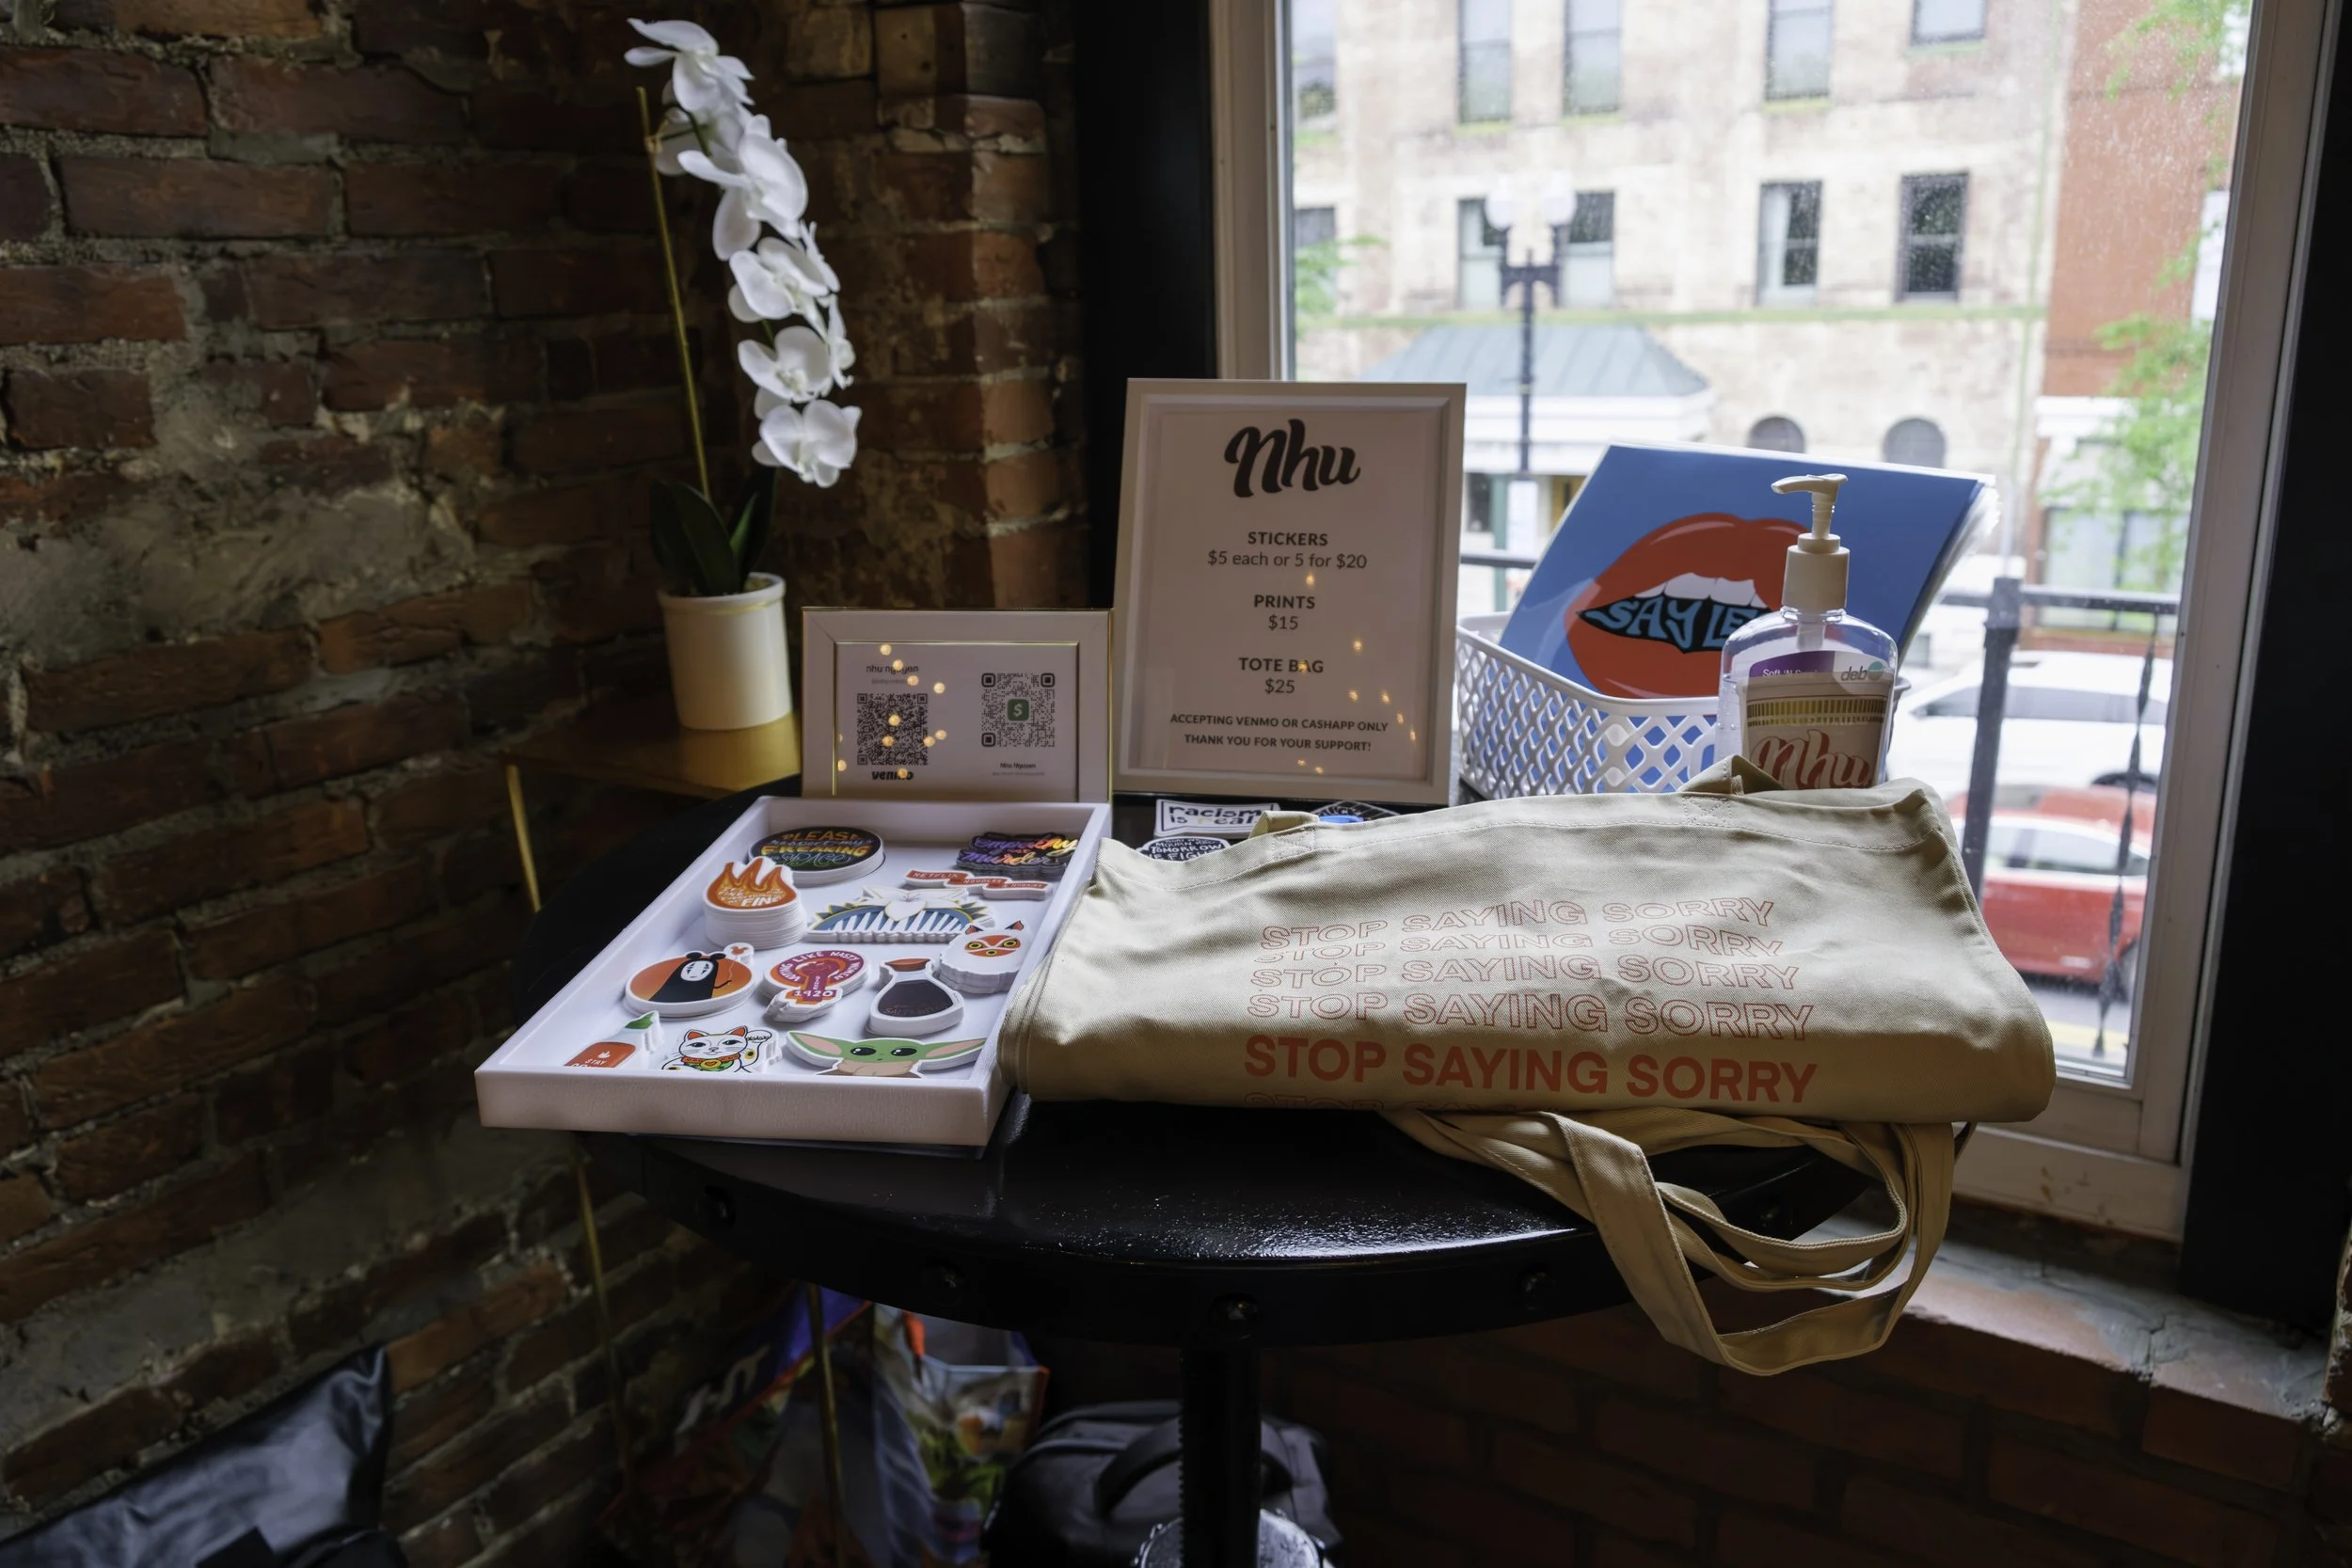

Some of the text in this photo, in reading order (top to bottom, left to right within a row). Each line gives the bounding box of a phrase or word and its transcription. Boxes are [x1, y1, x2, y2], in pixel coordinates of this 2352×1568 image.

[1224, 419, 1360, 498] Nhu
[1248, 531, 1328, 546] STICKERS
[1208, 549, 1367, 569] $5 each or 5 for $20
[1254, 594, 1315, 609] PRINTS
[1268, 614, 1298, 630] $15
[1584, 597, 1758, 648] SAY LE
[1238, 657, 1324, 673] TOTE BAG
[1841, 666, 1867, 681] deb
[1264, 677, 1295, 694] $25
[1170, 714, 1388, 732] ACCEPTING VENMO OR CASHAPP ONLY
[1184, 734, 1371, 752] THANK YOU FOR YOUR SUPPORT!
[1168, 806, 1262, 817] racism
[1170, 815, 1187, 824] is
[761, 845, 869, 857] FREAKING
[1151, 844, 1222, 854] TOMORROW
[1261, 897, 1774, 950] STOP SAYING SORRY
[1400, 933, 1594, 952] SAYING
[1609, 925, 1783, 957] SORRY
[792, 951, 824, 962] LIKE
[830, 951, 861, 960] NASTY
[1250, 954, 1799, 990] STOP SAYING SORRY
[1247, 992, 1814, 1040] STOP SAYING SORRY
[1244, 1034, 1818, 1103] STOP SAYING SORRY
